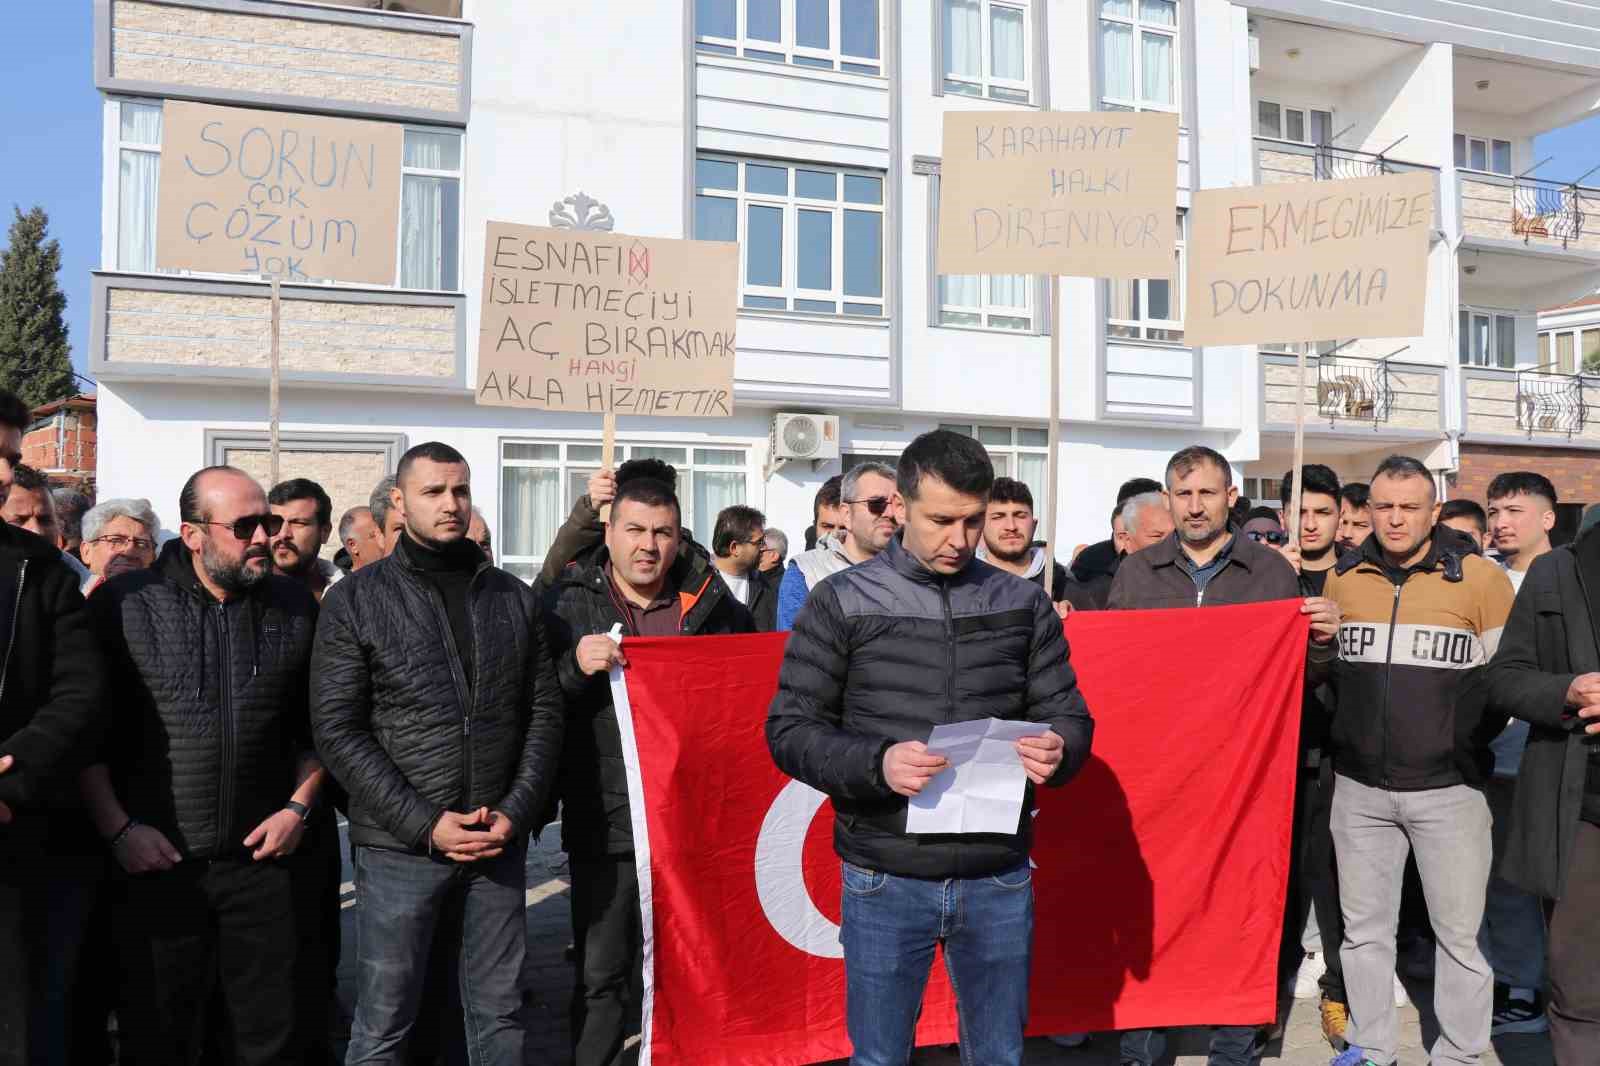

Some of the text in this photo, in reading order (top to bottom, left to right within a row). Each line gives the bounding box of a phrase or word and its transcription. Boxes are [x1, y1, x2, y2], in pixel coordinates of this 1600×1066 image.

[184, 121, 375, 191] SORUN
[975, 125, 1133, 160] KARAHAYIT
[248, 182, 310, 209] ÇOK
[1051, 167, 1130, 196] HALKI
[186, 202, 357, 257] ÇÖZÜM
[1210, 267, 1387, 318] DOKUNMA
[496, 316, 736, 360] AÇ BIRAKMAK
[480, 370, 564, 406] AKLA
